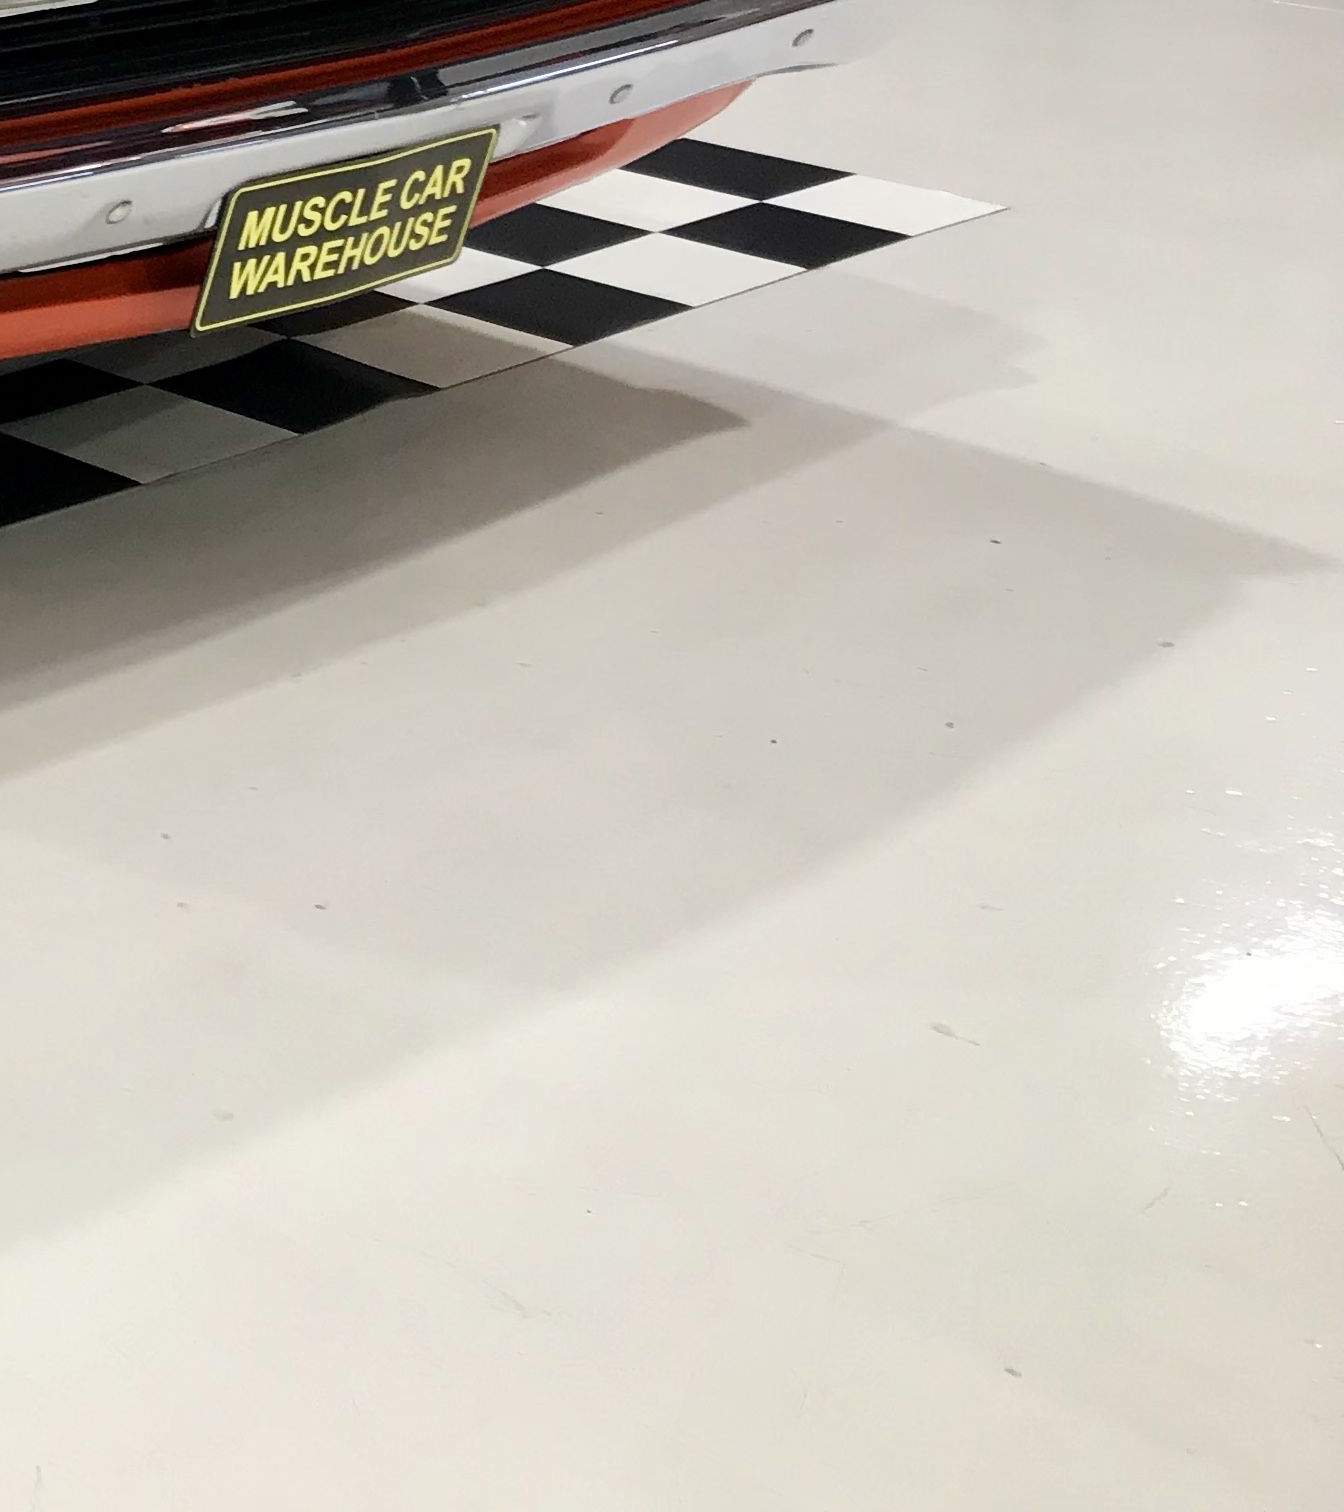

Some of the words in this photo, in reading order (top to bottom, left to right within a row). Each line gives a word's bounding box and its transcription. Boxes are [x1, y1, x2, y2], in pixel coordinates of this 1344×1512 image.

[228, 204, 458, 300] WAREHOUSE
[237, 177, 398, 252] MUSCLE
[398, 157, 472, 208] CAR
